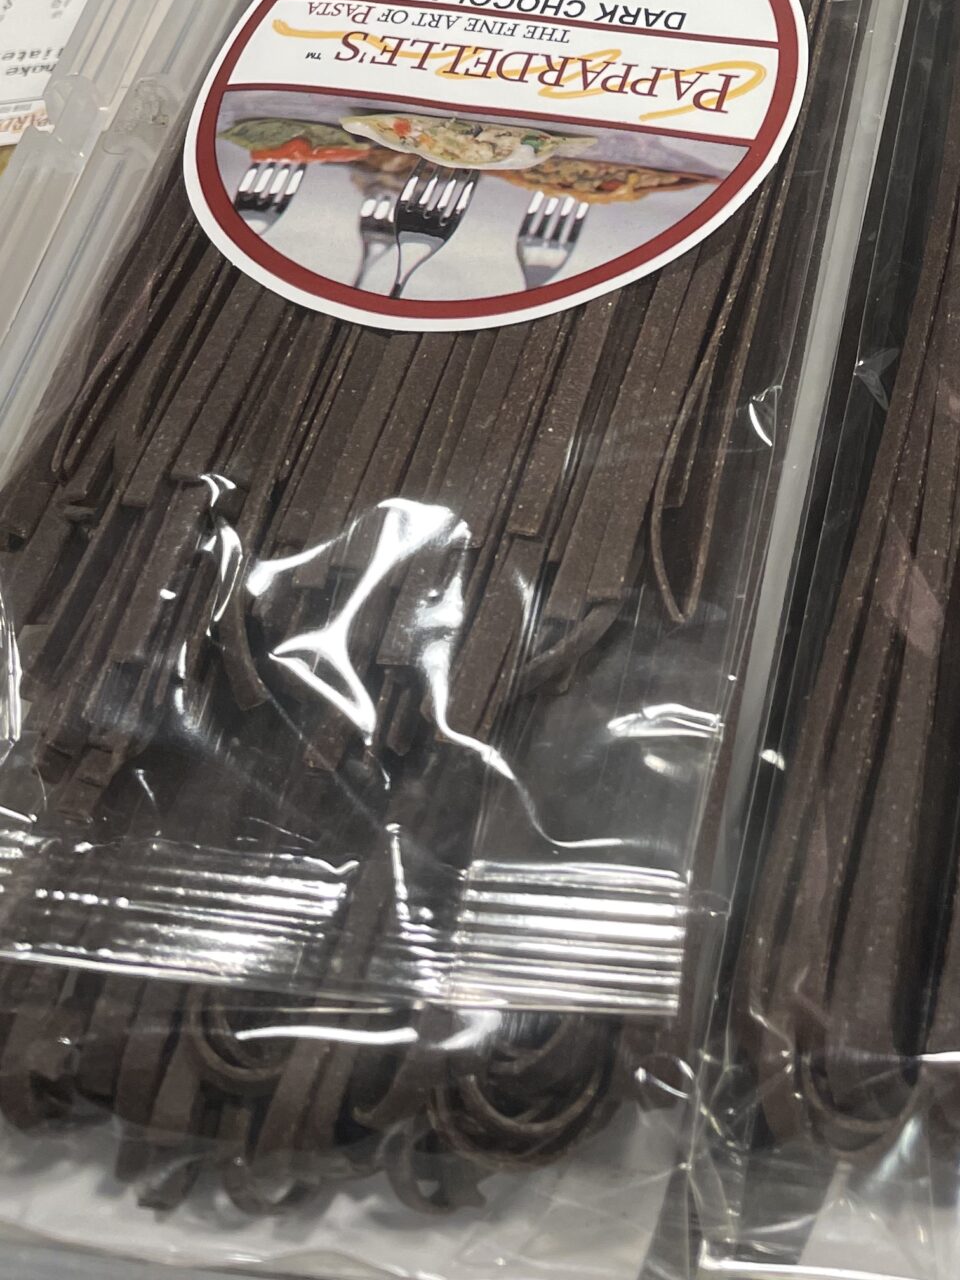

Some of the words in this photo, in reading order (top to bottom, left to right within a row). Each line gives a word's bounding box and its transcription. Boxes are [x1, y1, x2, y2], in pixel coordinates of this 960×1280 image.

[307, 0, 375, 26] PASTA
[377, 8, 409, 25] OF
[411, 13, 461, 31] ART
[594, 2, 687, 31] DARK
[463, 17, 521, 38] FINE
[522, 24, 571, 44] THE
[334, 31, 741, 114] PAPPARDELLE'S
